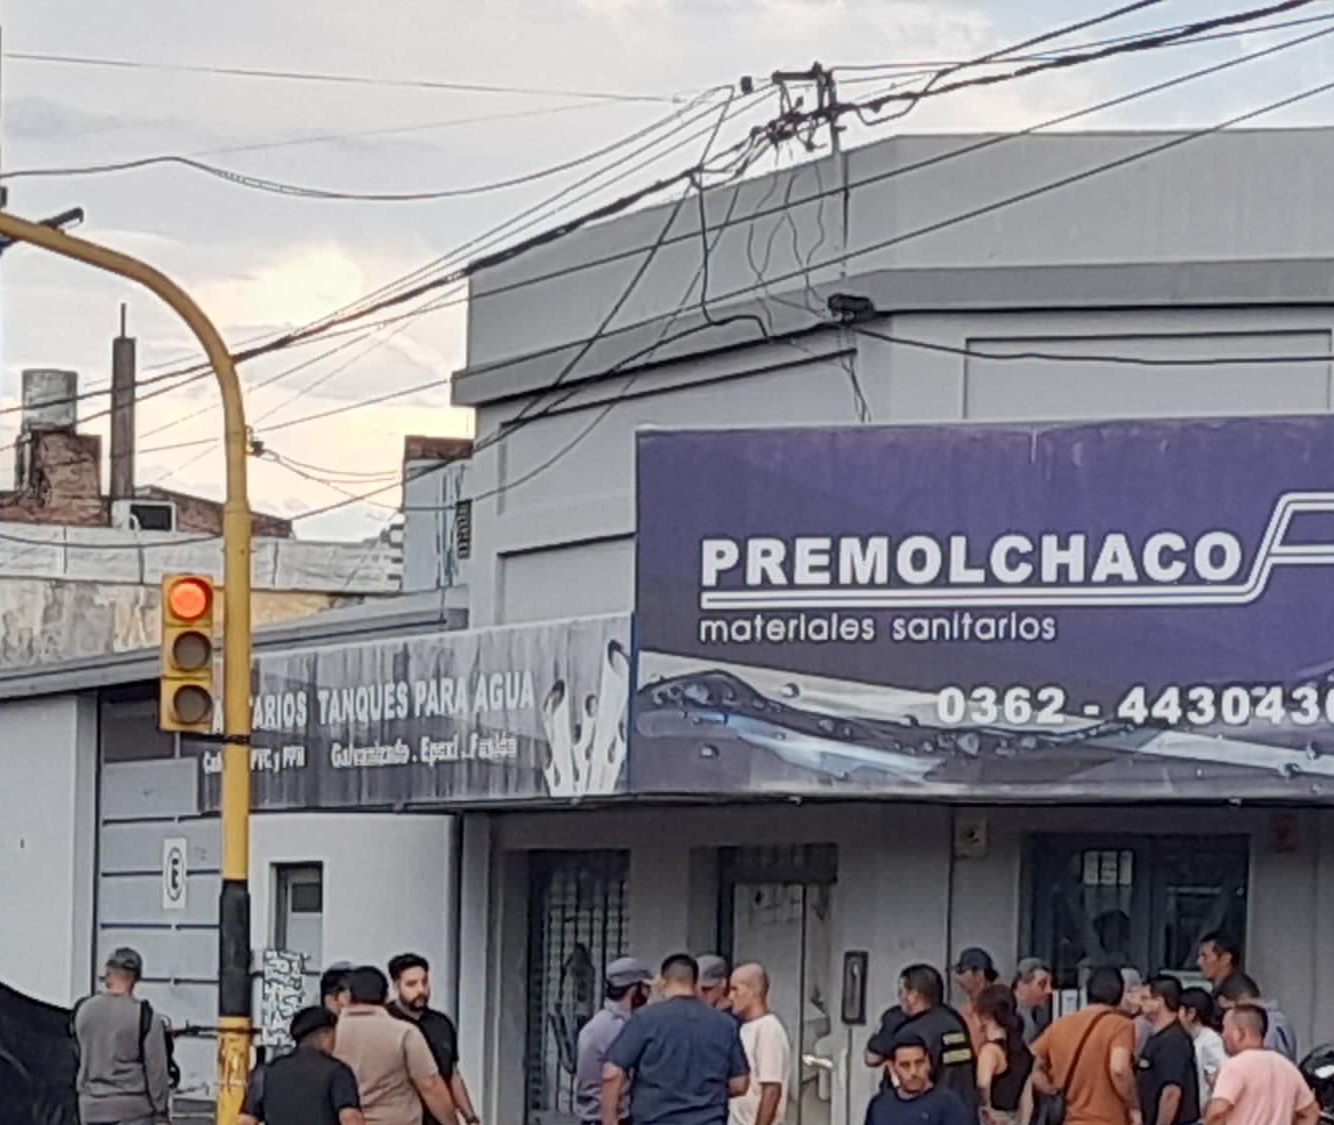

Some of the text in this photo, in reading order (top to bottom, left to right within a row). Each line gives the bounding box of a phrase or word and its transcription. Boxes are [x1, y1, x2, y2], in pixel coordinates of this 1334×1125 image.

[700, 532, 1243, 587] PREMOLCHACO
[699, 611, 1058, 643] materiales sanitarios
[318, 680, 409, 725] TANQUES
[415, 676, 467, 717] PARA
[473, 669, 535, 714] AGUA
[936, 686, 1066, 725] 0362
